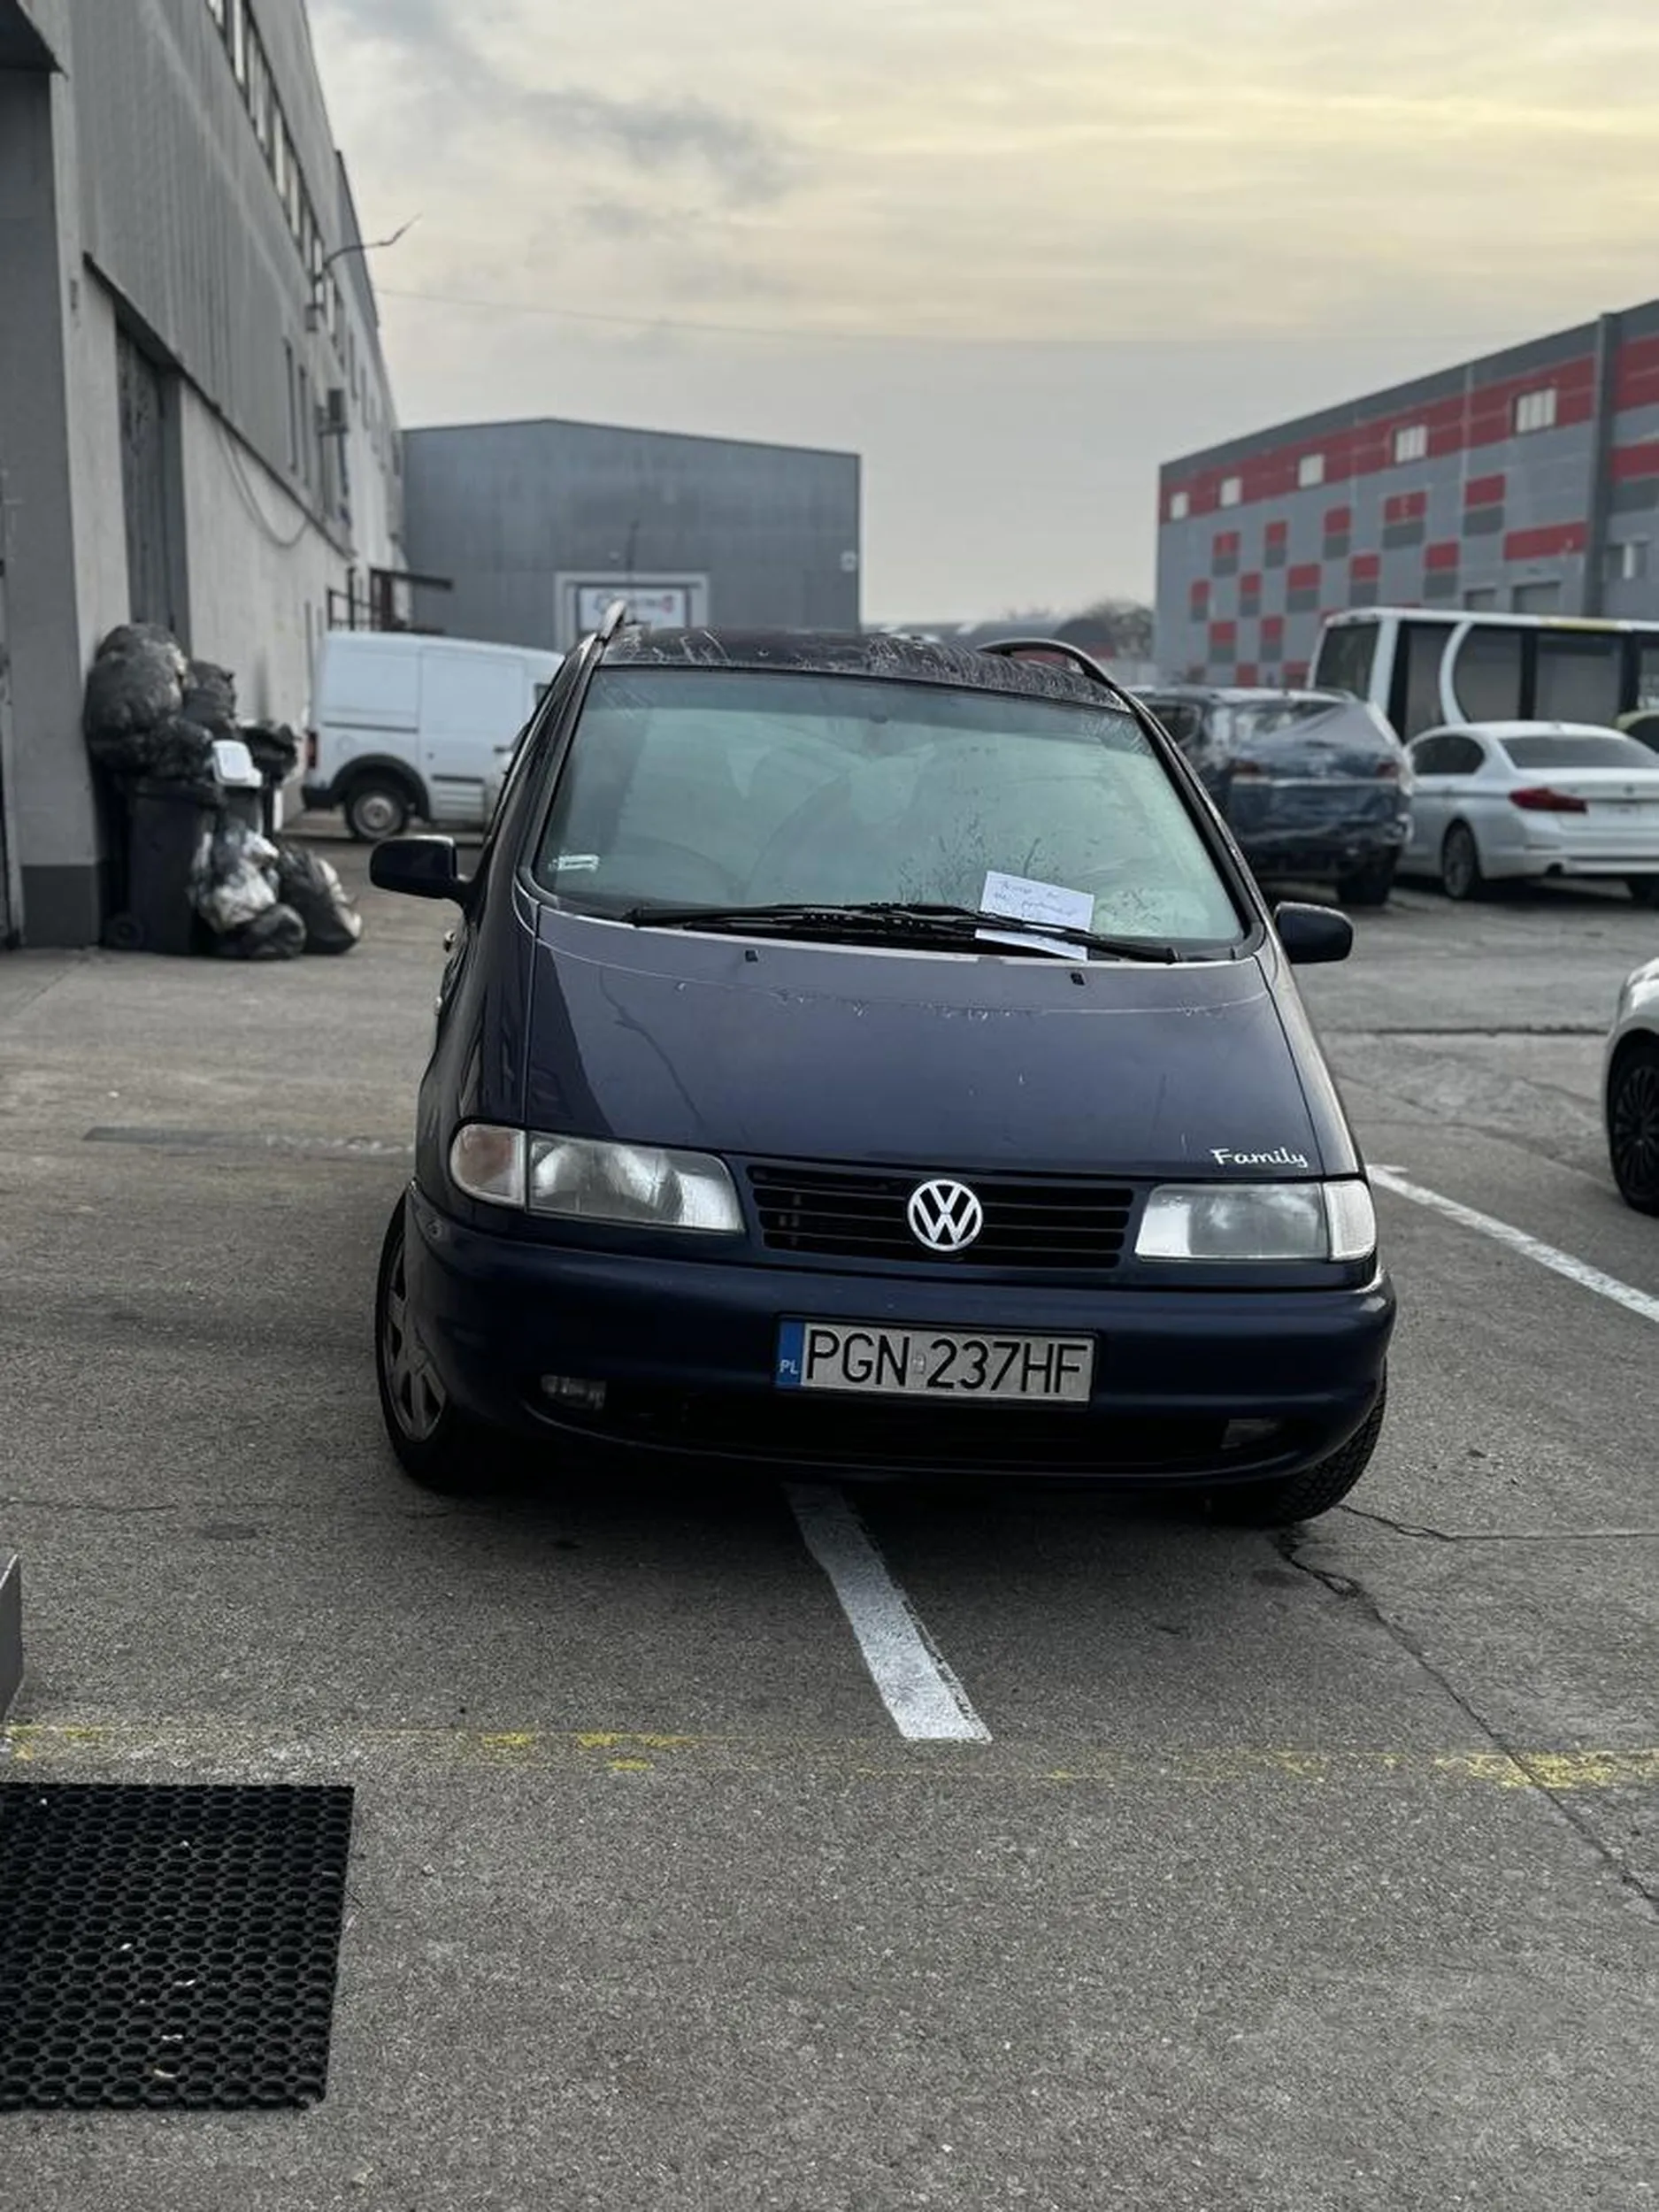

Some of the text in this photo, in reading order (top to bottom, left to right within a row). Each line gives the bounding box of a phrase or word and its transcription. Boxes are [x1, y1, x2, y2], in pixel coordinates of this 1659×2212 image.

[1209, 1146, 1308, 1168] Family
[910, 1180, 979, 1248] VW
[779, 1358, 799, 1375] PL
[806, 1329, 1088, 1394] PGN 237HF
